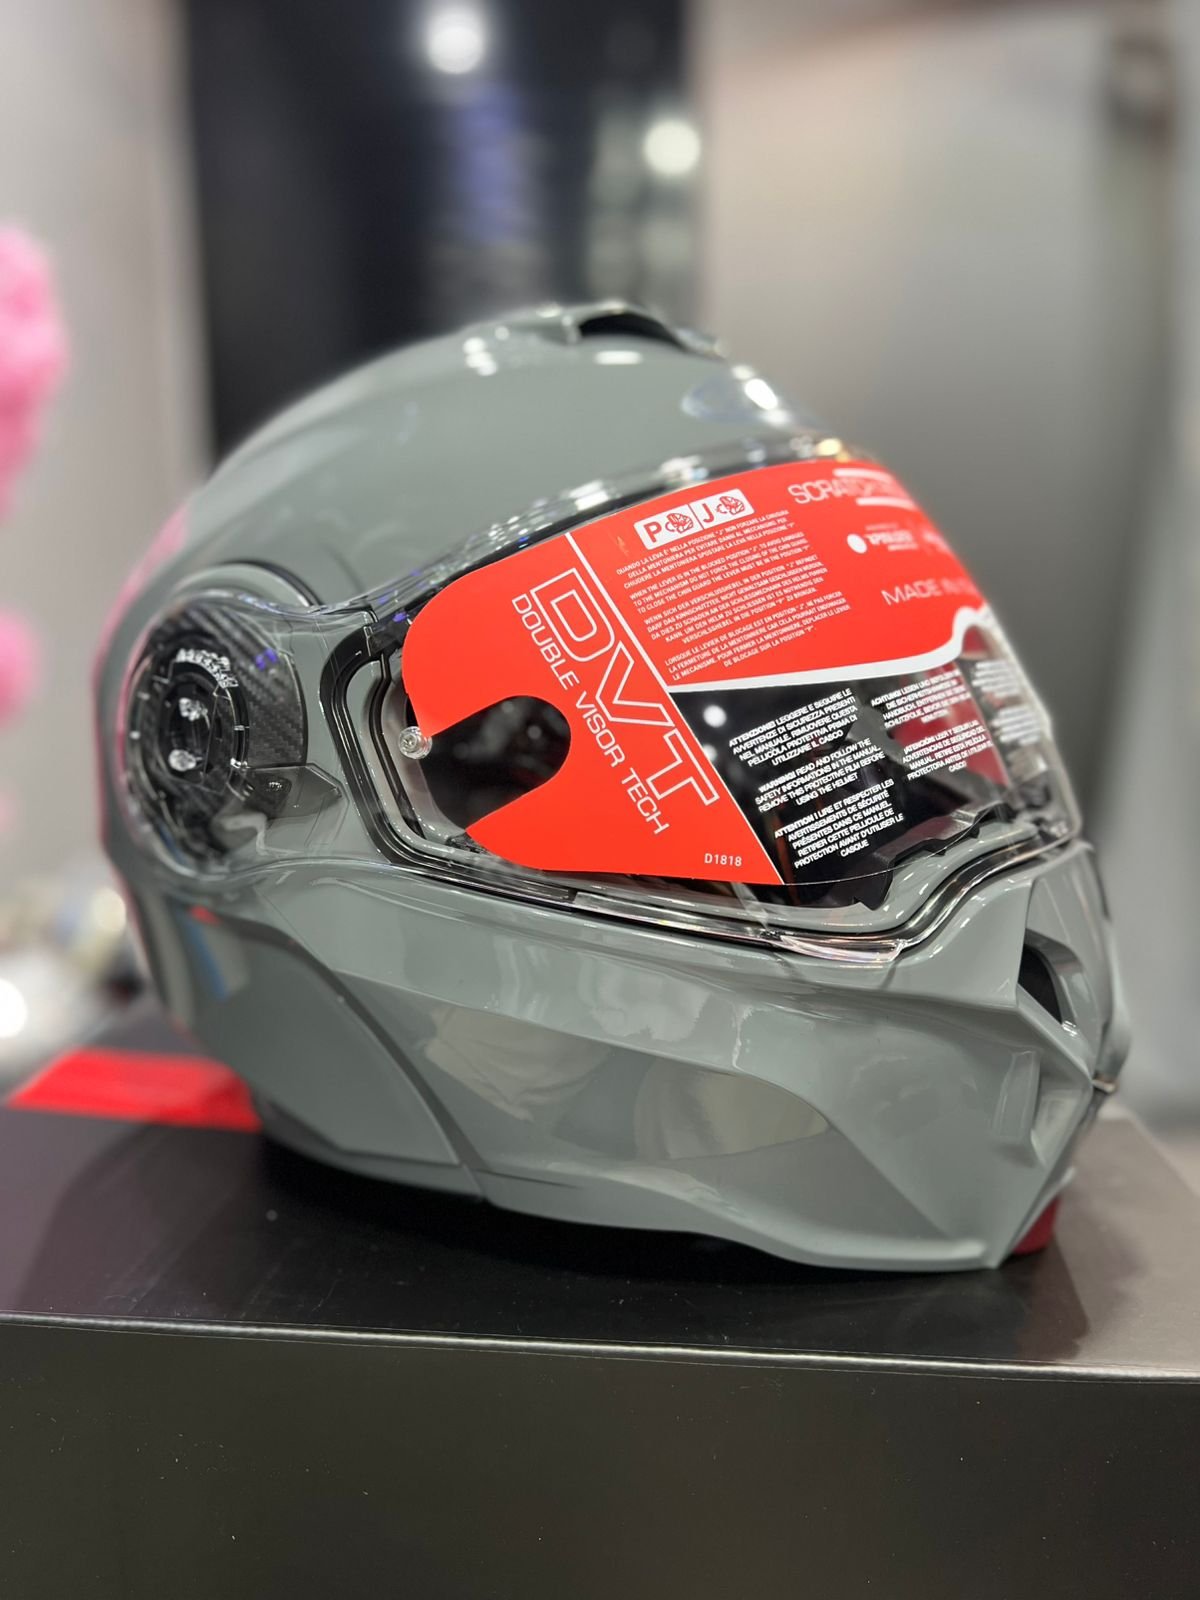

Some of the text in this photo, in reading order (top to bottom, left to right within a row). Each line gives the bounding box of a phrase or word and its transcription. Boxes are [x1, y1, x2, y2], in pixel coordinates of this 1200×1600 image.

[702, 503, 714, 522] J
[643, 521, 662, 543] P
[616, 560, 641, 575] QUANDO
[640, 557, 649, 565] LA
[649, 551, 664, 562] LEVA
[628, 567, 647, 578] DELLA
[684, 548, 696, 556] PER
[629, 588, 648, 600] WHEN
[647, 583, 659, 592] THE
[659, 576, 677, 588] LEVER
[690, 567, 701, 575] THE
[701, 557, 726, 571] BLOCKED
[652, 569, 661, 577] LA
[634, 560, 739, 607] TO THE MECHANISM DO NOT FORCE THE
[637, 606, 646, 614] TO
[646, 598, 666, 611] CLOSE
[665, 593, 677, 602] THE
[677, 587, 692, 597] CHIN
[692, 579, 712, 592] GUARD
[712, 575, 724, 584] THE
[723, 568, 741, 579] LEVER
[644, 601, 690, 625] WENN SICH DER
[651, 631, 661, 640] DA
[660, 625, 675, 636] DIES
[674, 622, 683, 630] ZU
[709, 607, 719, 615] AN
[718, 602, 731, 611] DER
[663, 616, 676, 626] DAS
[684, 625, 695, 634] UM
[695, 620, 708, 630] DEN
[707, 613, 725, 624] HELM
[668, 643, 729, 673] LA DE LA
[692, 646, 700, 654] LE
[699, 637, 720, 651] LEVIER
[719, 634, 728, 642] DE
[672, 673, 681, 681] LE
[724, 658, 733, 667] DE
[530, 568, 720, 806] DVT
[512, 593, 670, 834] DOUBLE VISOR TECH
[776, 706, 809, 726] LEGGERE
[809, 704, 815, 712] E
[843, 688, 852, 697] LE
[732, 695, 856, 755] AVVERTENZE DI SICUREZZA PRESENTI
[739, 748, 755, 761] NEL
[831, 703, 858, 721] QUESTA
[747, 713, 858, 767] PELLICOLA PROTETTIVA PRIMA DI
[772, 729, 844, 766] UTILIZZARE IL CASCO
[796, 762, 816, 777] READ
[815, 755, 831, 768] AND
[830, 743, 858, 761] FOLLOW
[857, 737, 871, 749] THE
[755, 787, 782, 805] SAFETY
[782, 764, 832, 793] INFORMATIONS
[831, 761, 840, 771] IN
[839, 755, 854, 767] THE
[758, 750, 885, 813] REMOVE THIS PROTECTIVE FILM BEFORE
[796, 772, 859, 806] USING THE HELMET
[774, 814, 815, 838] ATTENTION
[818, 805, 834, 818] LIRE
[834, 801, 844, 811] ET
[843, 783, 882, 807] RESPECTER
[881, 778, 895, 790] LES
[827, 827, 850, 844] CETTE
[849, 812, 885, 834] PELLICULE
[884, 807, 894, 818] DE
[833, 816, 853, 831] DANS
[852, 812, 863, 822] CE
[847, 804, 858, 815] DE
[794, 843, 839, 869] PROTECTION
[838, 832, 861, 849] AVANT
[895, 813, 904, 823] LE
[840, 838, 870, 858] CASQUE
[704, 853, 742, 867] D1818
